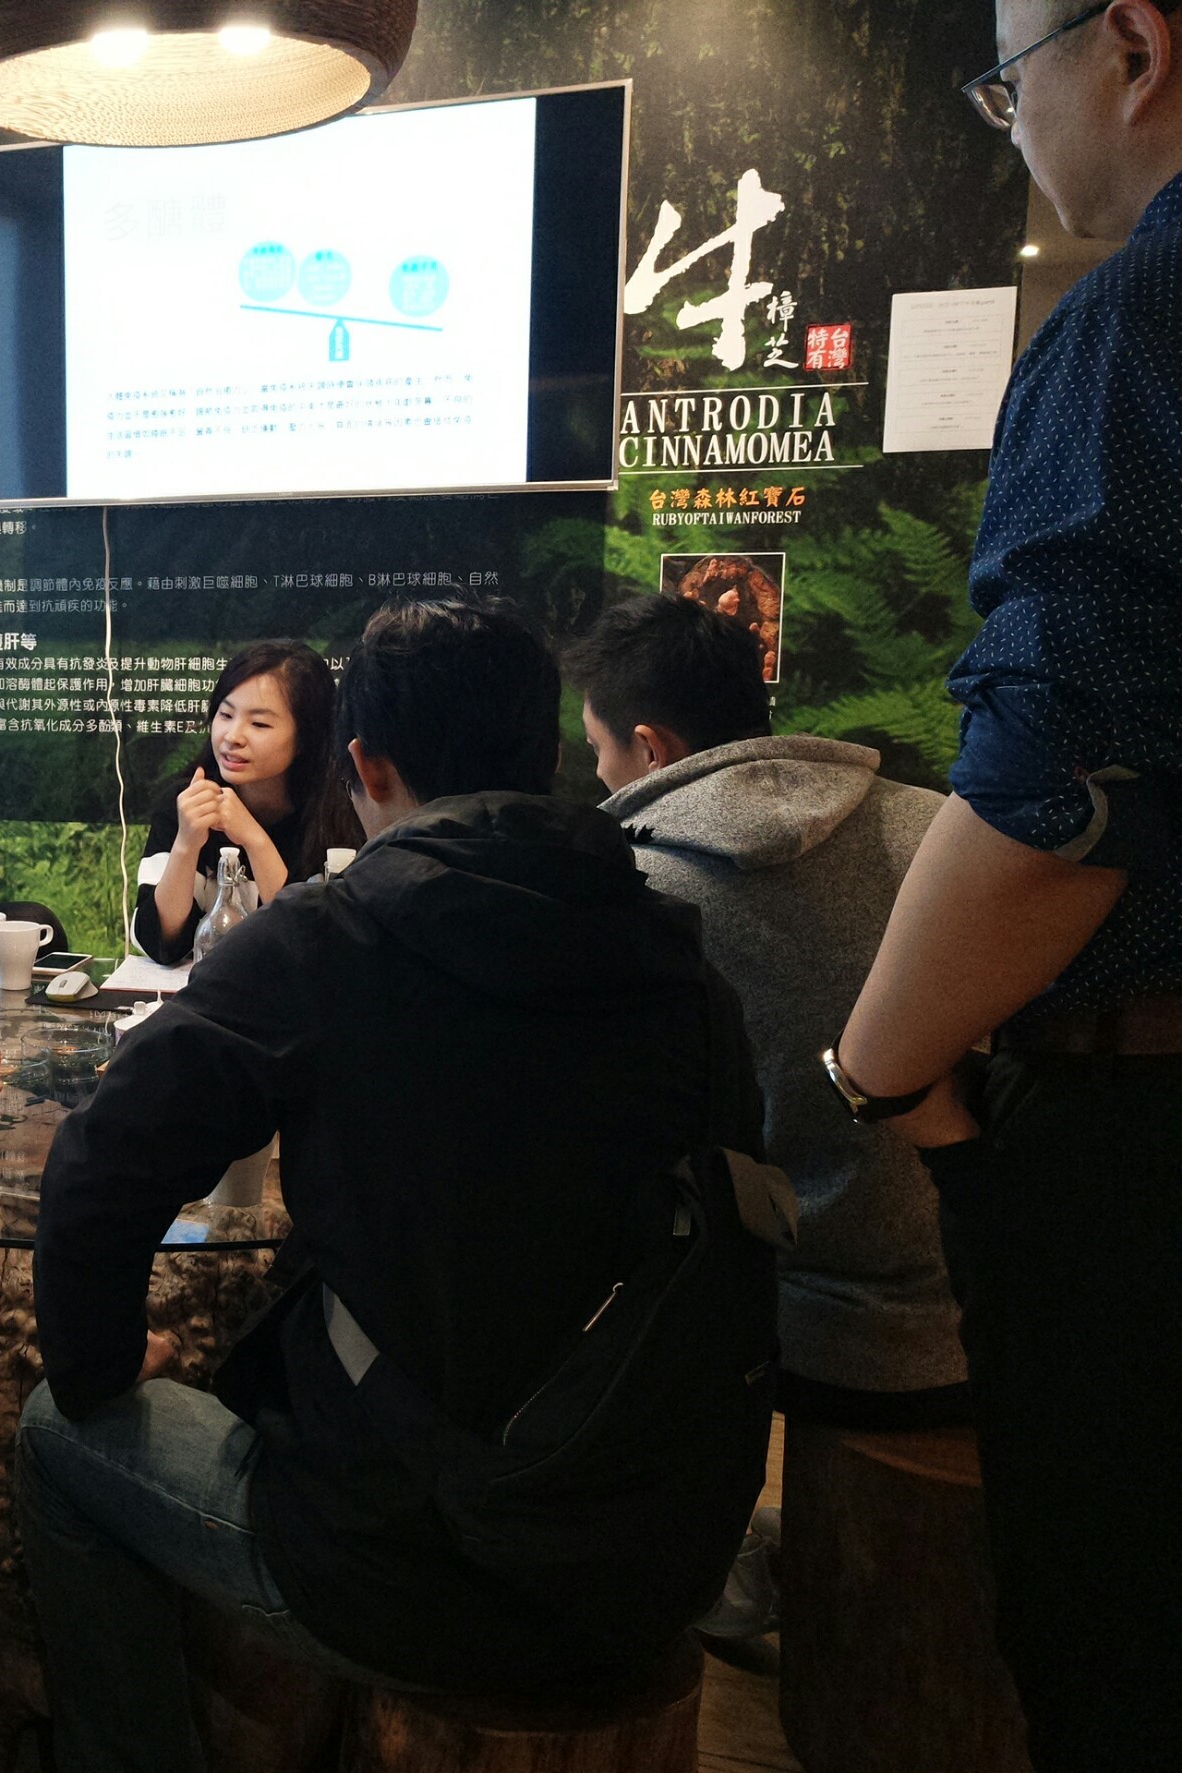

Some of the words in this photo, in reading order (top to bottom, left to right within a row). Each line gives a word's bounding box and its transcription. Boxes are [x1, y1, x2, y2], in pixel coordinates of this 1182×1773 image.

[620, 392, 836, 434] ANTRODIA
[619, 430, 835, 468] CINNAMOMEA
[649, 486, 806, 510] 台灣森林紅寶石
